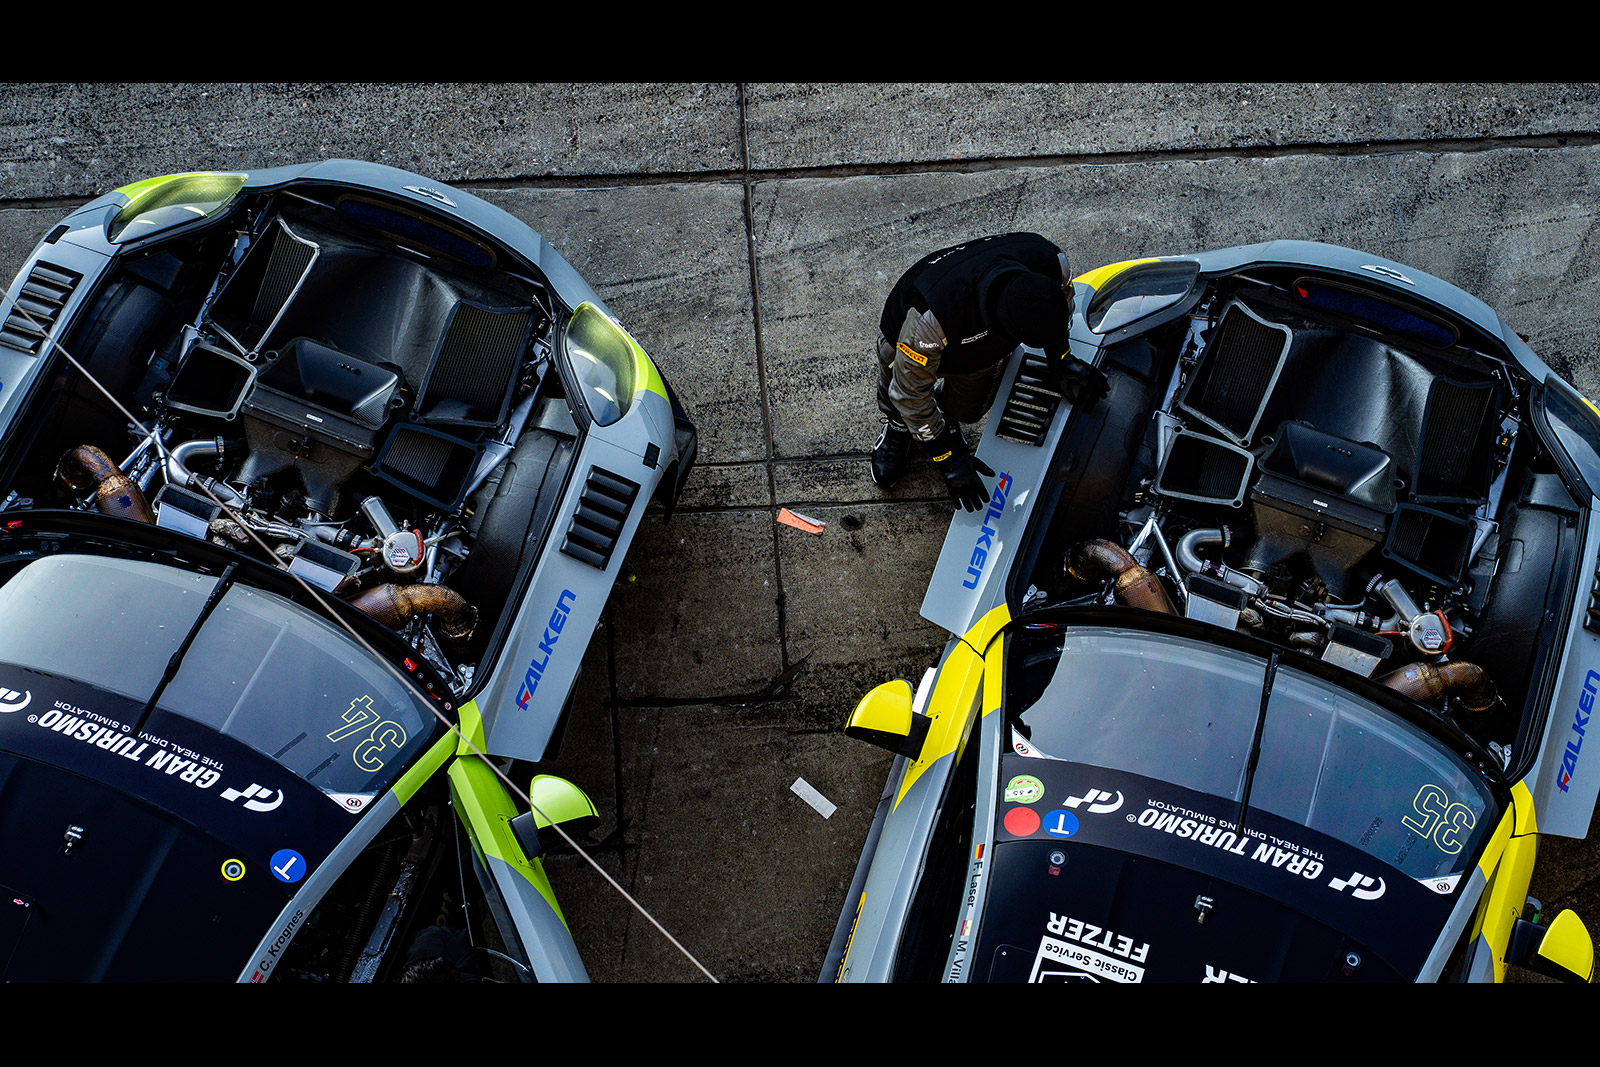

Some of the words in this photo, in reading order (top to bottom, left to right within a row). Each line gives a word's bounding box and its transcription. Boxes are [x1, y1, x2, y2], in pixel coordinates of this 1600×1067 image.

[963, 471, 1013, 590] FALKEN
[515, 589, 577, 711] FALKEN
[54, 700, 121, 730] SIMULATOR
[122, 723, 169, 747] DRIVIG
[326, 695, 407, 772] 34
[1557, 669, 1600, 793] FALKEN
[171, 742, 200, 763] REAL
[201, 756, 224, 771] THE
[145, 751, 221, 789] GRAN
[1148, 798, 1217, 824] SIMULATOR
[1401, 784, 1476, 855] 35
[1049, 814, 1070, 835] T
[1219, 819, 1267, 841] DRING
[1270, 836, 1299, 853] REAL
[1303, 848, 1325, 862] THE
[273, 856, 298, 880] T
[972, 861, 983, 871] F.
[1251, 843, 1324, 880] GRAN
[967, 874, 981, 907] Laser
[259, 960, 273, 972] C.
[268, 909, 304, 958] Krognes
[955, 940, 968, 955] M.
[1046, 911, 1150, 963] FETZER
[1045, 943, 1091, 966] Service
[1094, 959, 1137, 981] Classic
